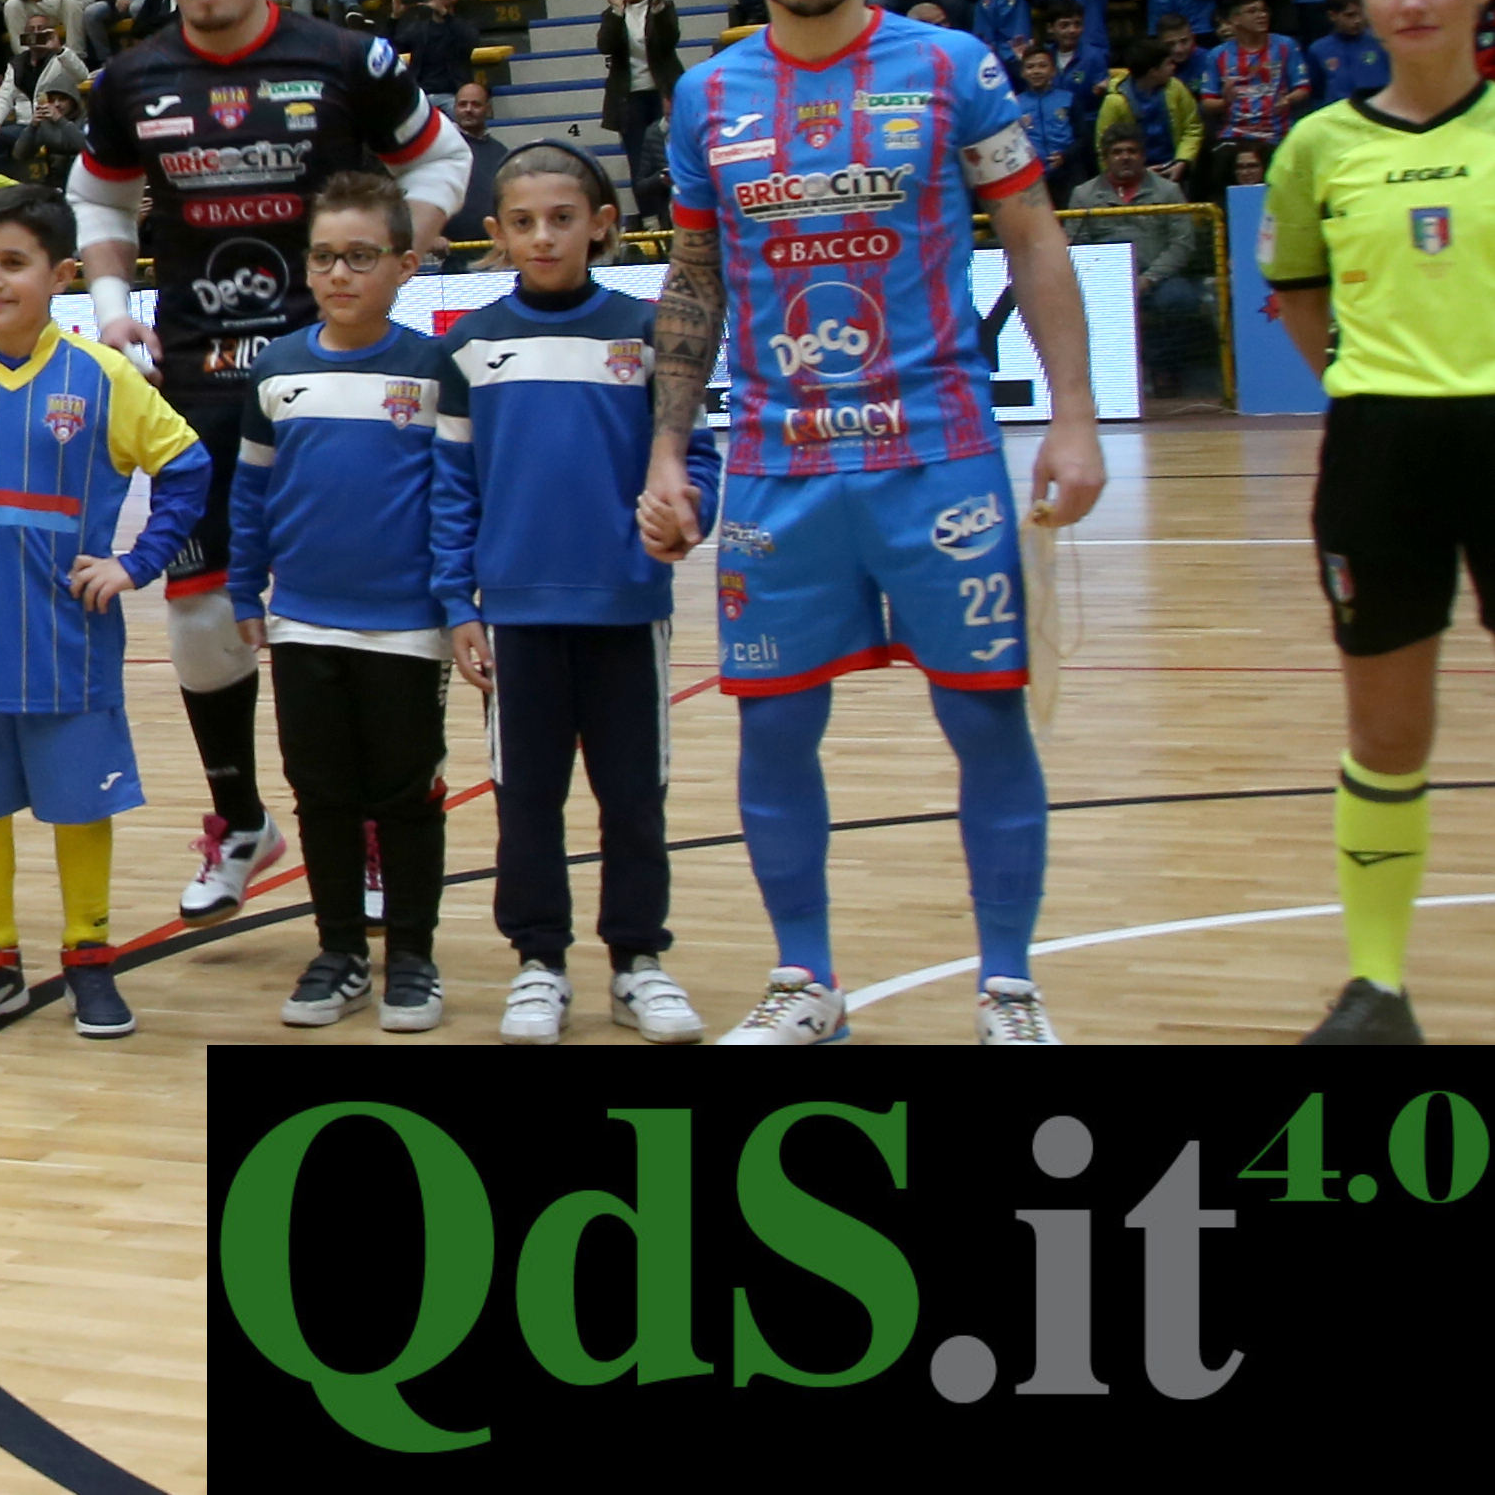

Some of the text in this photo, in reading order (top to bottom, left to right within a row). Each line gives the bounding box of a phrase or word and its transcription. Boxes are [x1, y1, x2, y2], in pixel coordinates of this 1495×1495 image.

[211, 89, 247, 103] META
[870, 94, 927, 106] DUSTY
[798, 103, 838, 119] META
[568, 124, 580, 136] 4
[1386, 166, 1468, 184] LEGEA
[210, 202, 294, 223] BACCO
[791, 233, 889, 262] BACCO
[935, 493, 1003, 545] Sial
[959, 573, 1017, 626] 22
[734, 635, 779, 662] celi
